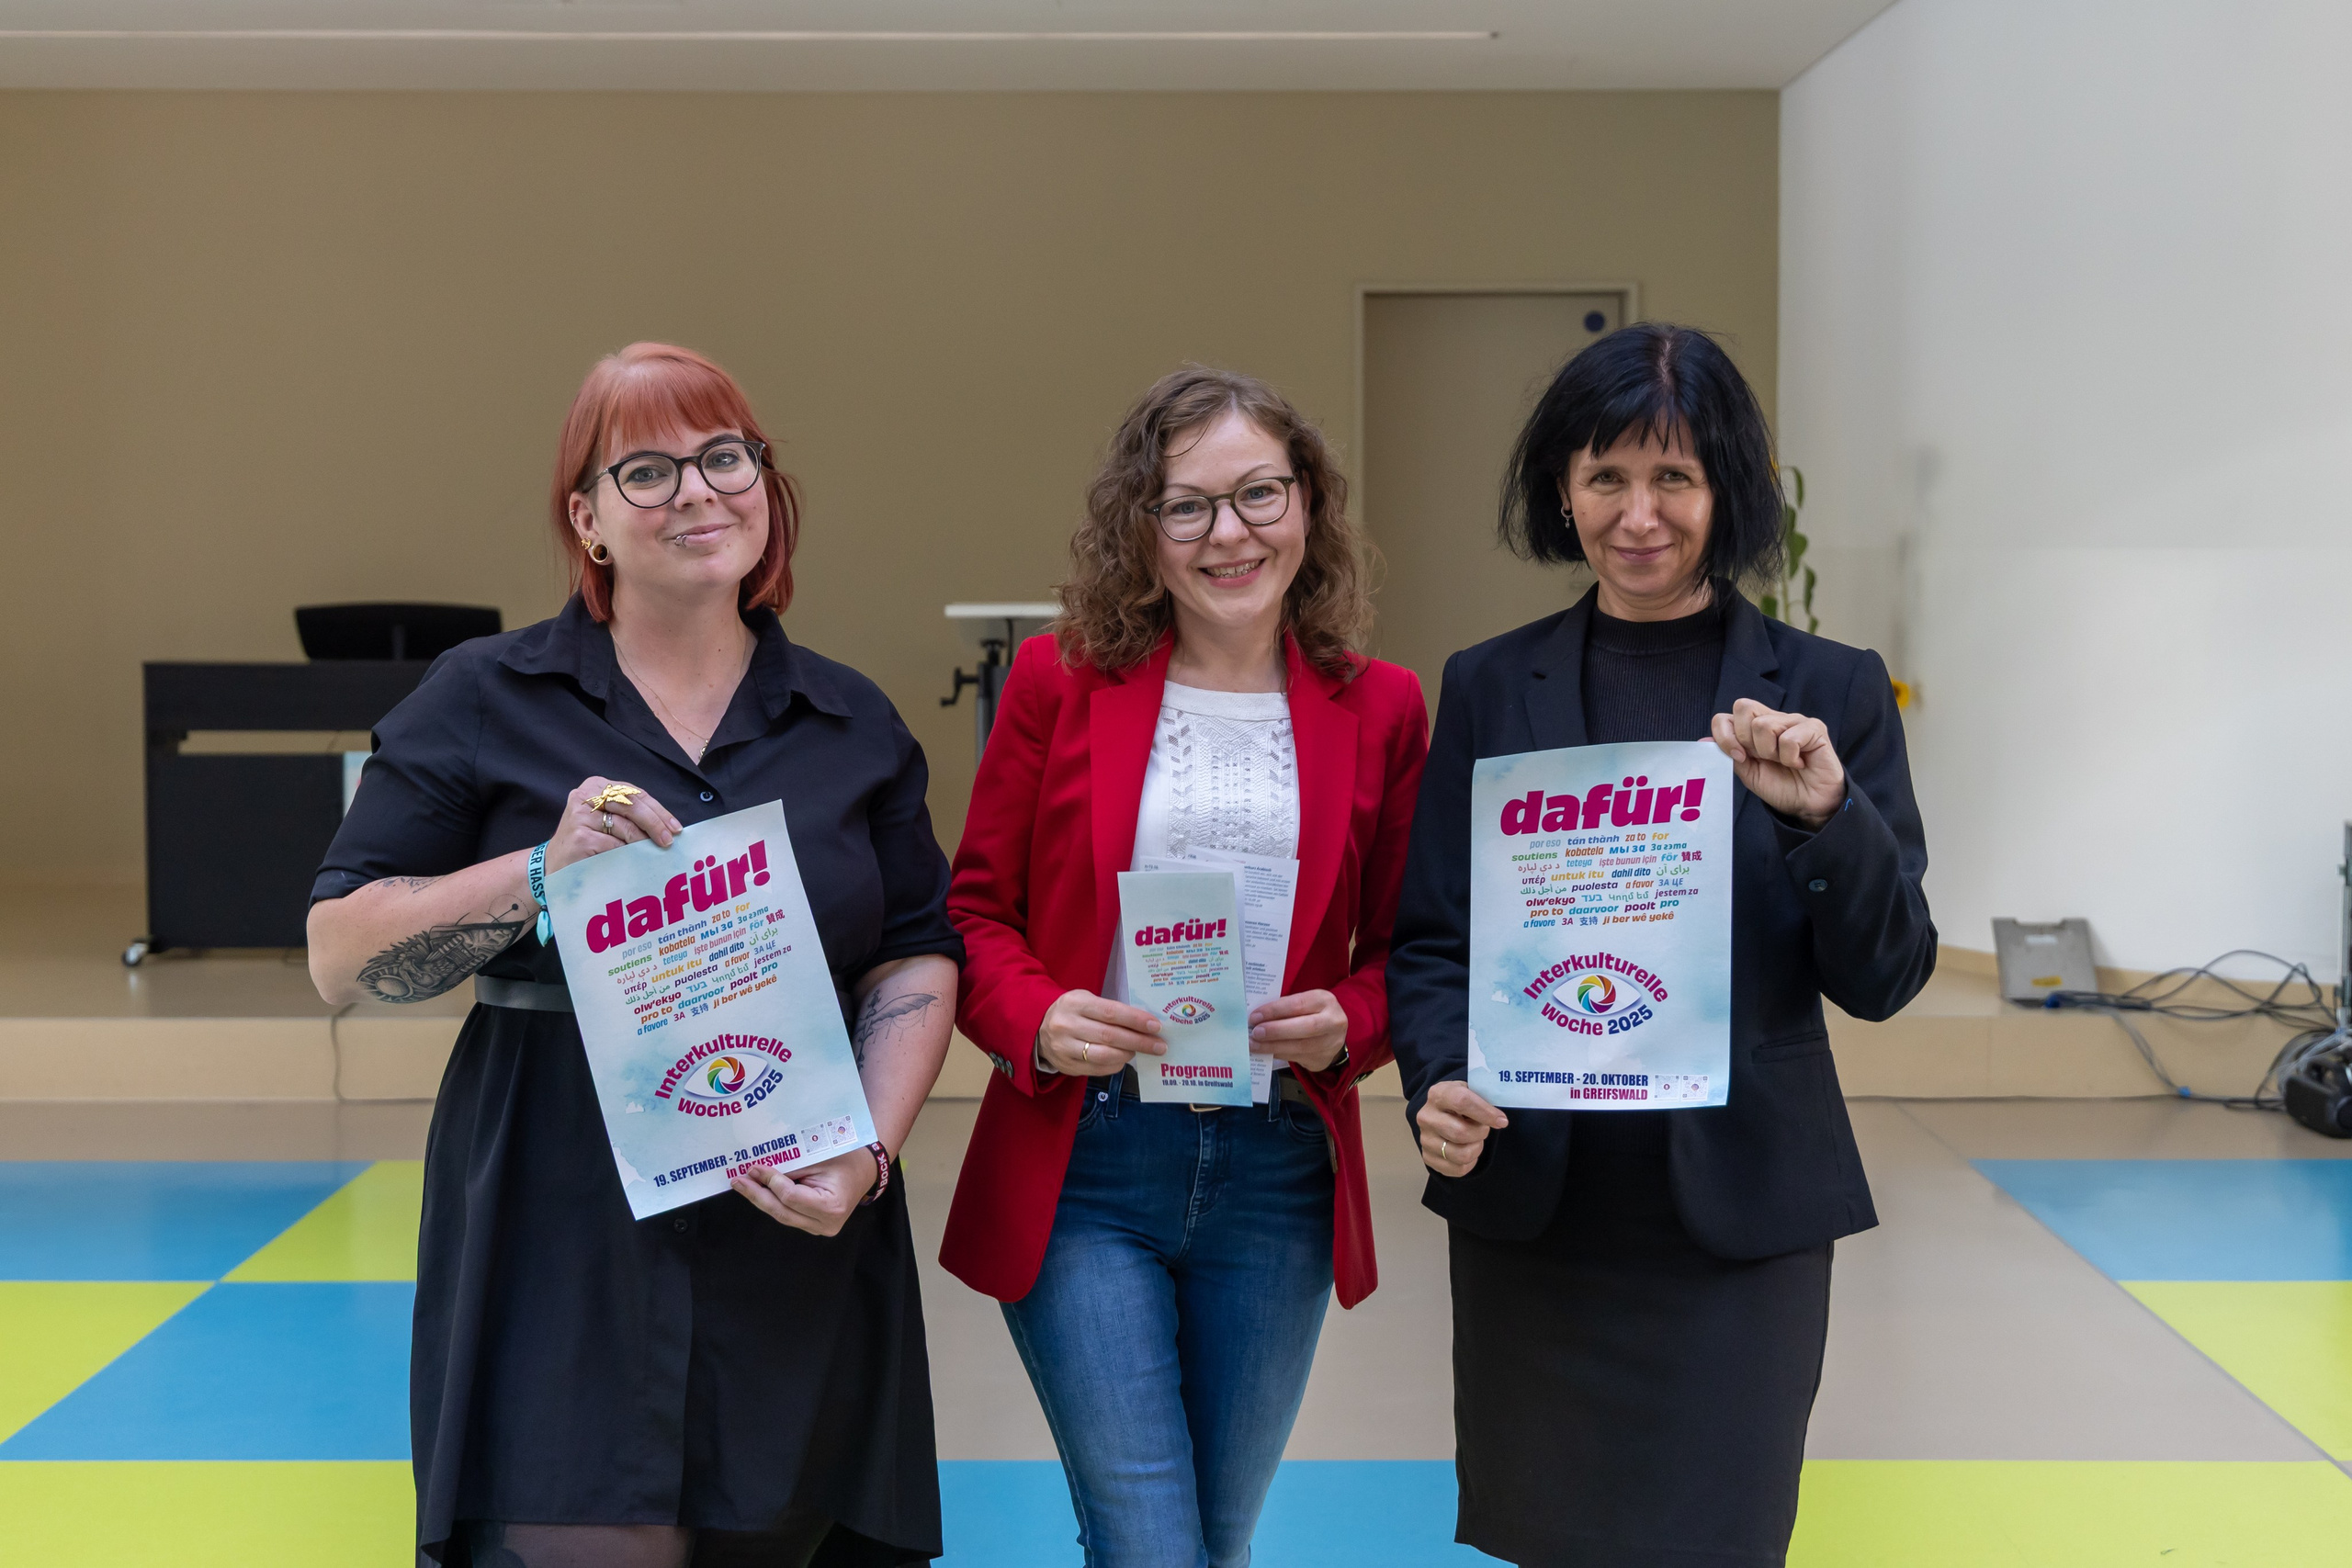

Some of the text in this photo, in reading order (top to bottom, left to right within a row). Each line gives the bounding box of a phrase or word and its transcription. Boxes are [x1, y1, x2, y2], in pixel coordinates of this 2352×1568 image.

[1500, 775, 1706, 836] dafür!
[1511, 852, 1558, 862] soutiens
[1565, 846, 1604, 857] kobatela
[1530, 832, 1669, 850] por eso tán thành za to for
[1551, 871, 1586, 882] untuk
[1589, 870, 1604, 879] itu
[1611, 868, 1633, 878] dahil
[1634, 867, 1651, 877] dito
[1566, 859, 1592, 868] teteya
[1600, 858, 1614, 868] işte
[1615, 857, 1640, 865] bunun
[1642, 855, 1657, 865] için
[1661, 852, 1678, 862] för
[530, 867, 545, 899] HASS
[585, 840, 771, 953] dafür!
[1571, 881, 1618, 893] puolesta
[1625, 881, 1631, 889] a
[1632, 880, 1654, 889] favor
[1655, 888, 1687, 899] jestem
[1530, 899, 1679, 918] pro to daarvoor poolt pro
[1530, 919, 1555, 928] favore
[1579, 916, 1598, 926] 支持
[1602, 916, 1610, 925] ji
[1632, 913, 1646, 921] wê
[1649, 911, 1674, 922] yekê
[622, 902, 751, 960] por eso tán thành za to for
[662, 950, 688, 965] teteya
[694, 943, 708, 955] işte
[709, 933, 732, 949] bunun
[732, 927, 747, 939] için
[749, 919, 764, 931] för
[1135, 918, 1227, 946] dafür!
[608, 954, 652, 976] soutiens
[659, 935, 695, 956] kobatela
[651, 964, 684, 984] untuk
[686, 958, 702, 970] itu
[708, 947, 729, 962] dahil
[729, 941, 745, 954] dito
[674, 964, 718, 987] puolesta
[725, 960, 729, 968] a
[731, 952, 751, 965] favor
[754, 950, 782, 968] jestem
[783, 944, 792, 954] za
[1523, 952, 1668, 1002] Interkulturelle
[641, 962, 778, 1024] pro to daarvoor poolt pro
[643, 1018, 668, 1033] favore
[690, 1002, 709, 1017] 支持
[713, 998, 719, 1009] ji
[721, 992, 738, 1004] ber
[740, 984, 753, 997] wê
[754, 974, 777, 991] yekê
[1162, 996, 1216, 1014] Interkulturelle
[1170, 1012, 1211, 1025] Woche 2025
[1541, 1002, 1653, 1036] Woche 2025
[655, 1033, 792, 1100] Interkulturelle
[1160, 1063, 1233, 1079] Programm
[1498, 1070, 1513, 1083] 19.
[1515, 1071, 1575, 1085] SEPTEMBER
[1583, 1073, 1600, 1086] 20.
[1601, 1074, 1649, 1087] OKTOBER
[677, 1068, 784, 1117] Woche 2025
[1570, 1087, 1648, 1100] in GREIFSWALD
[653, 1174, 670, 1188] 19.
[670, 1155, 728, 1182] SEPTEMBER
[734, 1148, 752, 1162] 20.
[752, 1134, 797, 1157] OKTOBER
[726, 1168, 737, 1179] in
[877, 1152, 888, 1188] BOCK
